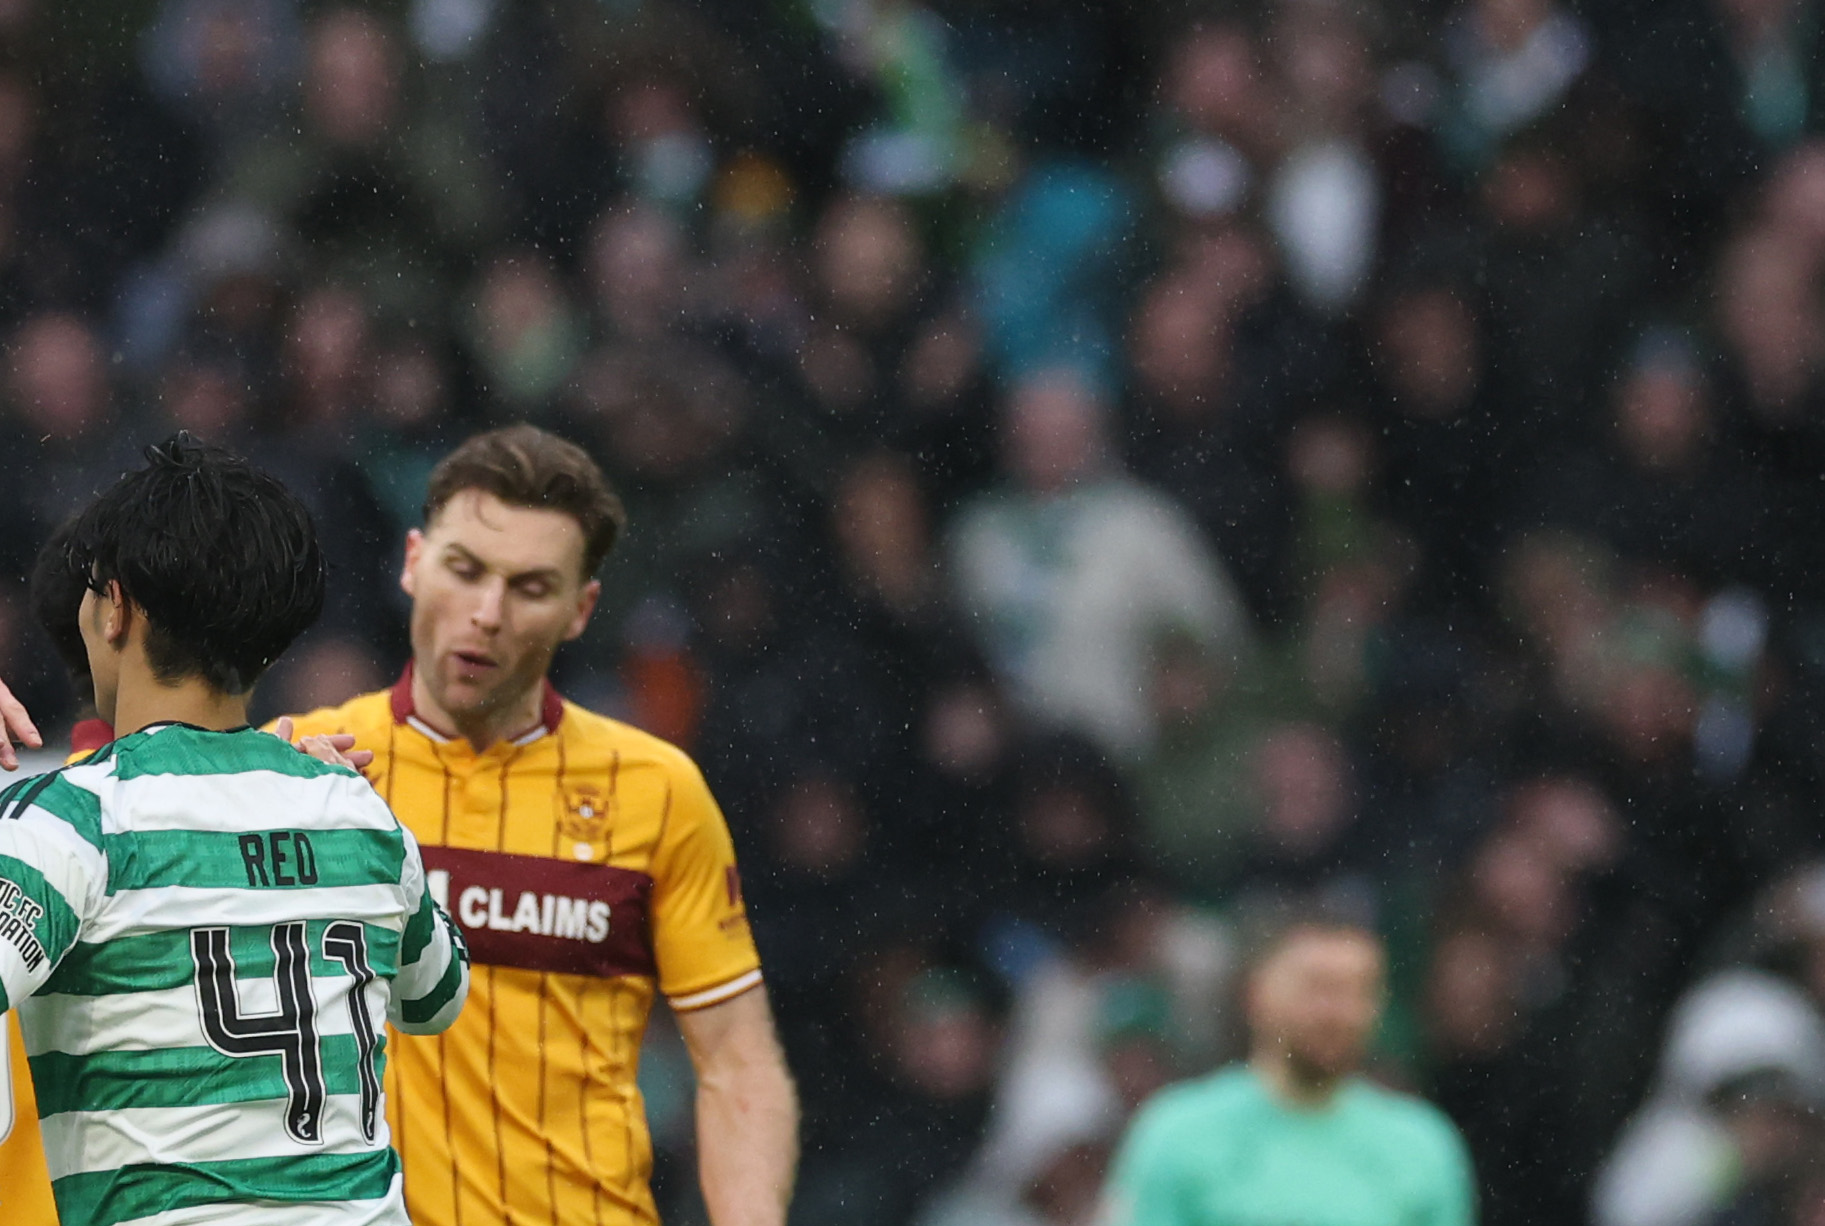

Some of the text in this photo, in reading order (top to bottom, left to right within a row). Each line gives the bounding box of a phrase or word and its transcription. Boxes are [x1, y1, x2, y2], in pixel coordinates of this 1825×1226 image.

[18, 899, 42, 928] FC
[459, 885, 611, 943] CLAIMS
[189, 919, 379, 1146] 41
